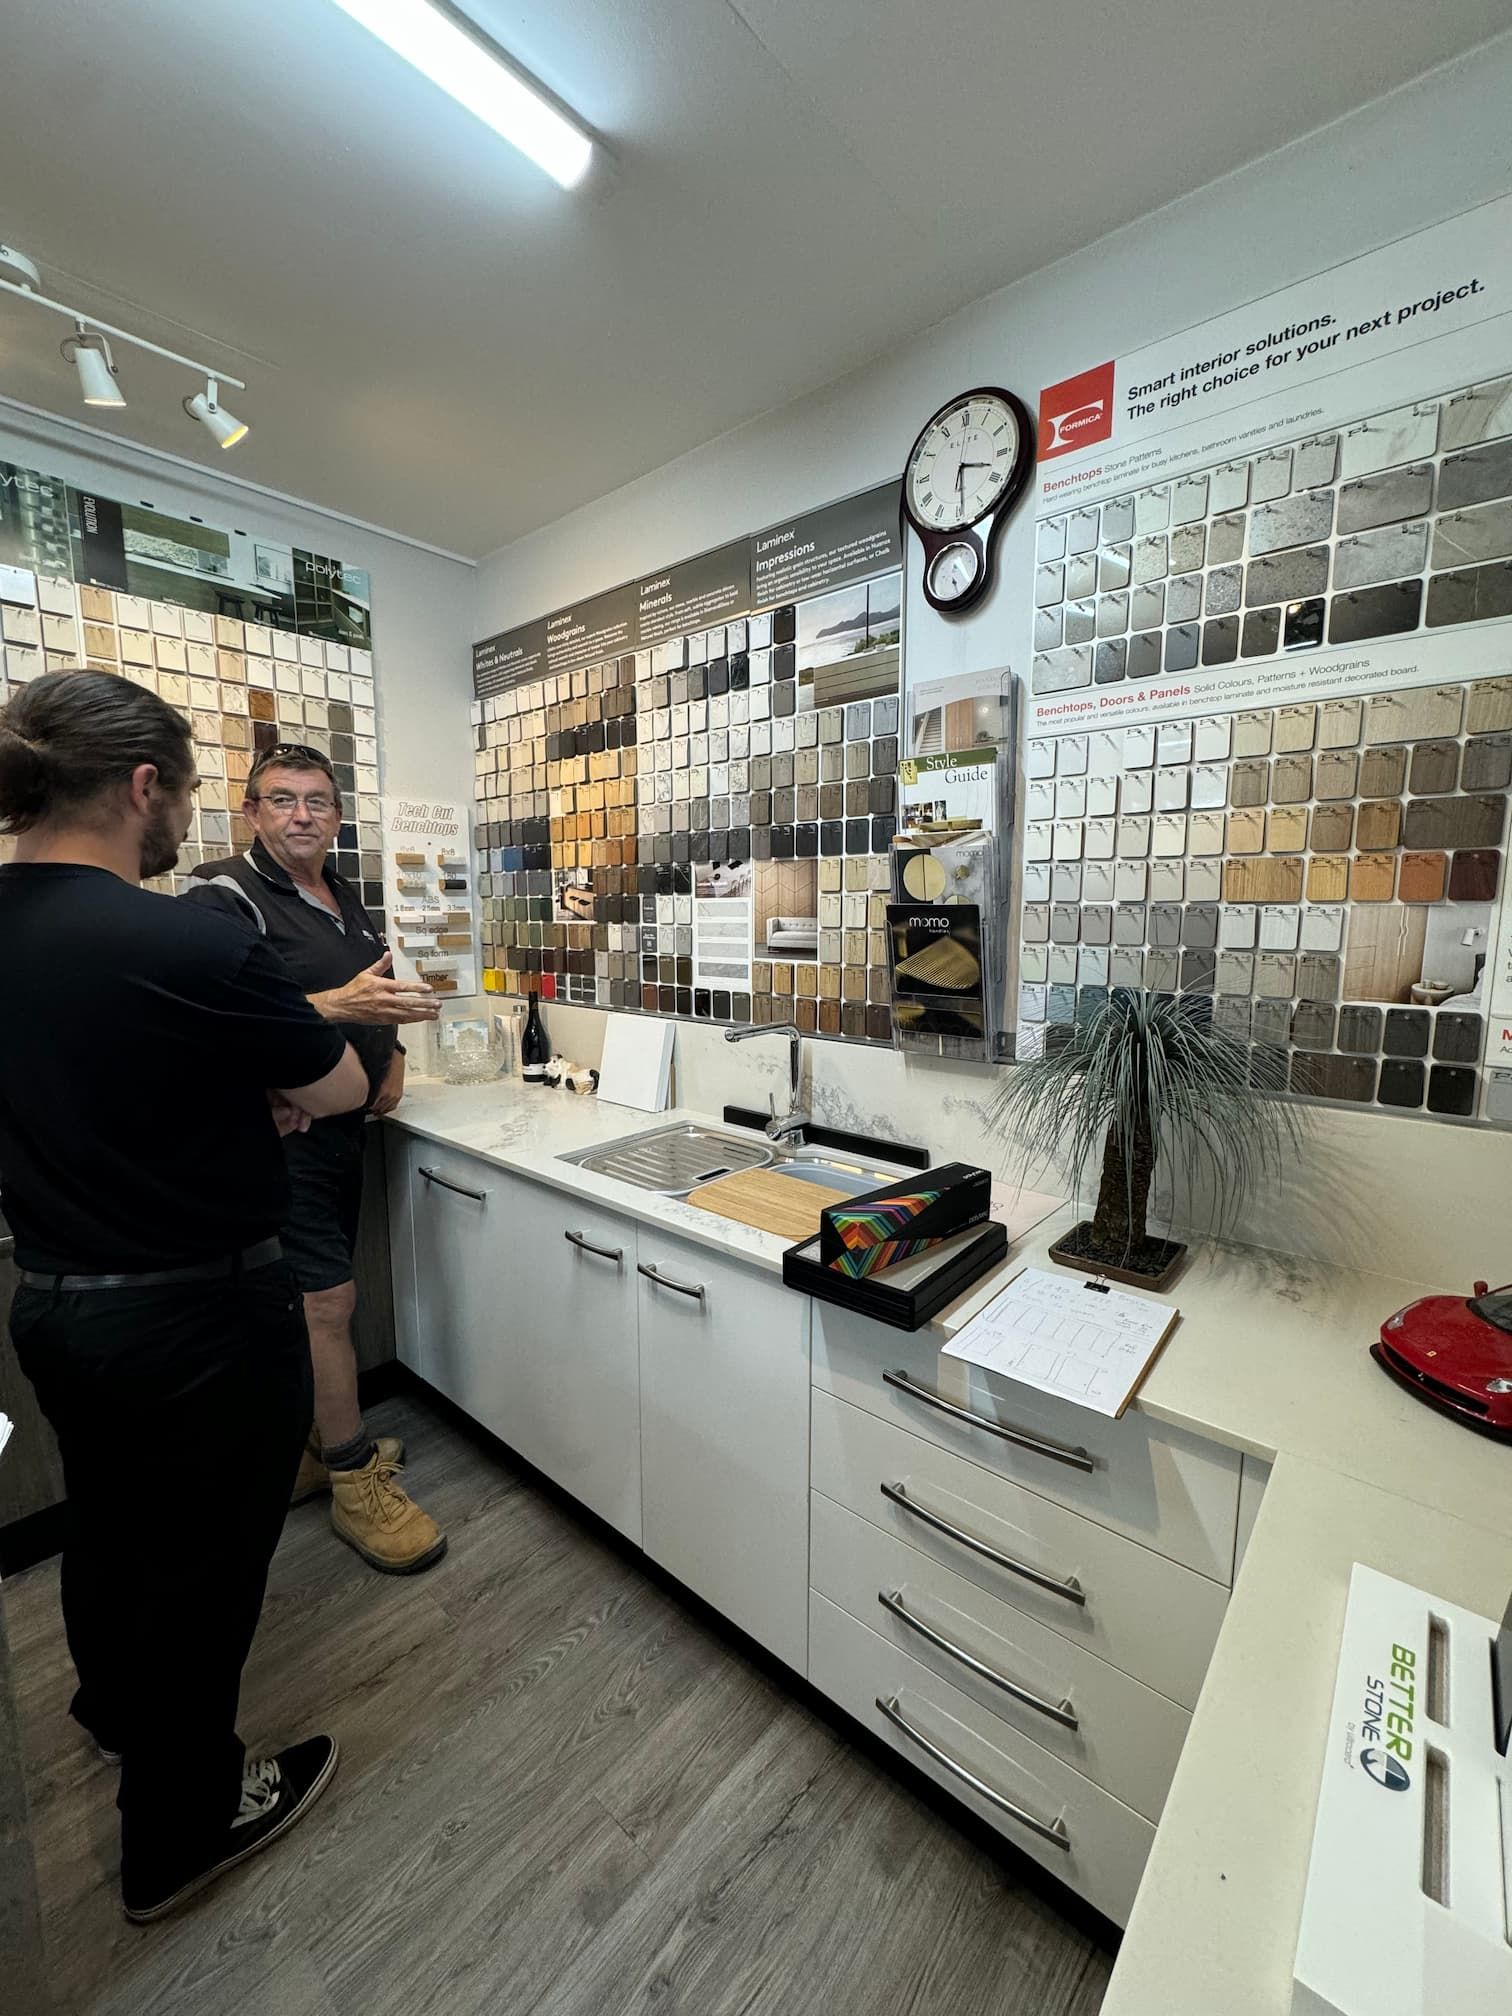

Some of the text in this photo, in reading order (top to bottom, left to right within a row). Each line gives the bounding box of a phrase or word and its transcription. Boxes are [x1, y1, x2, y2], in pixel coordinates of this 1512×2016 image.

[1127, 278, 1485, 420] The right choice for your next project.
[1128, 314, 1337, 401] Smart interior solutions.
[1201, 436, 1236, 452] bathroom
[1239, 425, 1266, 440] vanities
[1268, 419, 1284, 431] and
[1043, 447, 1162, 493] Benchtops Stone Patterns
[83, 496, 99, 535] EVOLUTION
[757, 530, 795, 553] Laminex
[756, 542, 815, 573] Impressions
[305, 561, 361, 584] polytec
[640, 577, 671, 597] Laminex
[639, 592, 672, 612] Minerals
[547, 615, 572, 630] Laminex
[547, 625, 586, 645] Woodgrains
[499, 647, 523, 663] Neutrals
[1036, 701, 1097, 717] Benchtops,
[1100, 694, 1134, 707] Doors
[1137, 691, 1146, 702] &
[1150, 685, 1191, 700] Panels
[1193, 682, 1216, 694] Solid
[1217, 678, 1255, 690] Colours,
[1257, 671, 1297, 683] Patterns
[1309, 659, 1371, 676] Woodgrains
[1189, 695, 1222, 706] benchtop
[1224, 690, 1255, 700] laminate
[1256, 687, 1271, 696] and
[1272, 682, 1307, 693] moisture
[1308, 677, 1342, 688] resistant
[1344, 670, 1388, 682] decorated
[1390, 665, 1419, 676] board.
[926, 753, 958, 770] Style
[945, 765, 988, 784] Guide
[399, 802, 454, 820] Tech Cut
[391, 817, 459, 836] Benchtops
[422, 895, 440, 904] ABS
[908, 917, 950, 928] momo
[417, 950, 429, 960] Sq
[420, 973, 449, 983] Timber
[1362, 1675, 1384, 1742] STONE
[1386, 1643, 1416, 1761] BETTER
